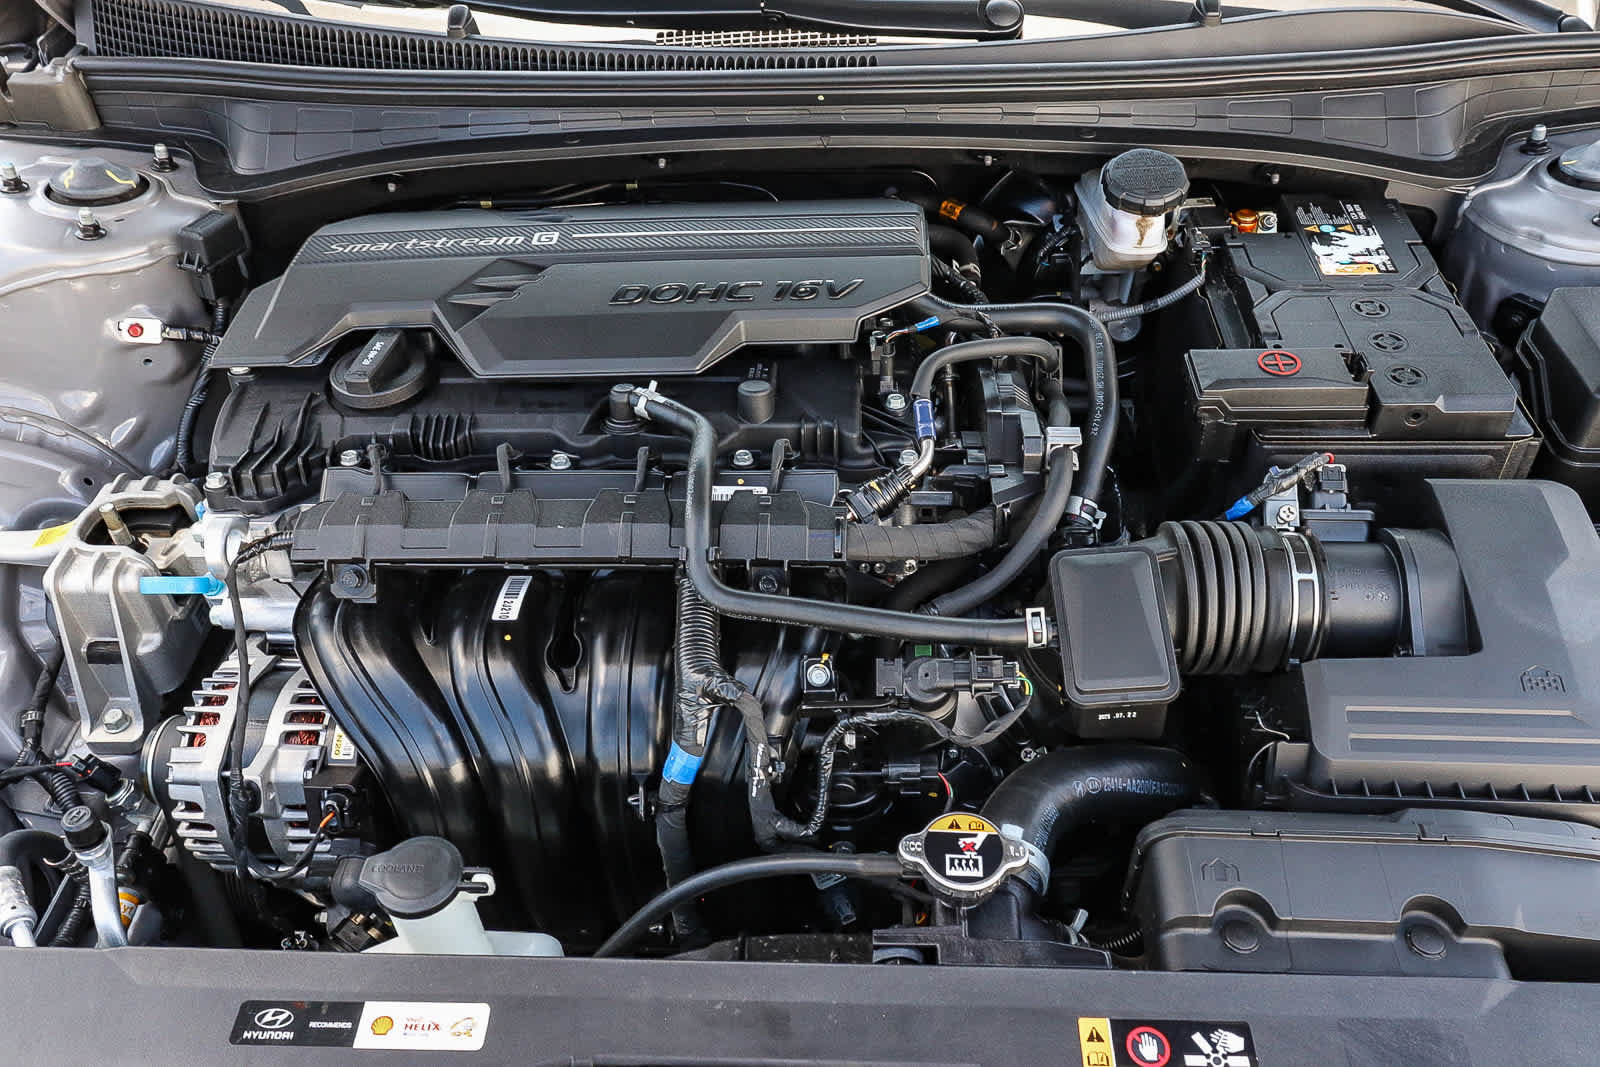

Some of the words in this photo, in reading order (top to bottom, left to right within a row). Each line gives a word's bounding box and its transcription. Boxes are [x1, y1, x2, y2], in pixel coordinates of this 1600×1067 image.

[323, 235, 525, 255] Smartstream
[531, 231, 560, 246] G
[608, 281, 763, 305] DOHC
[773, 279, 865, 301] 16V
[308, 1021, 353, 1029] RECOMMENDS
[404, 1022, 440, 1032] HELIX
[242, 1030, 295, 1041] HYUNDAI
